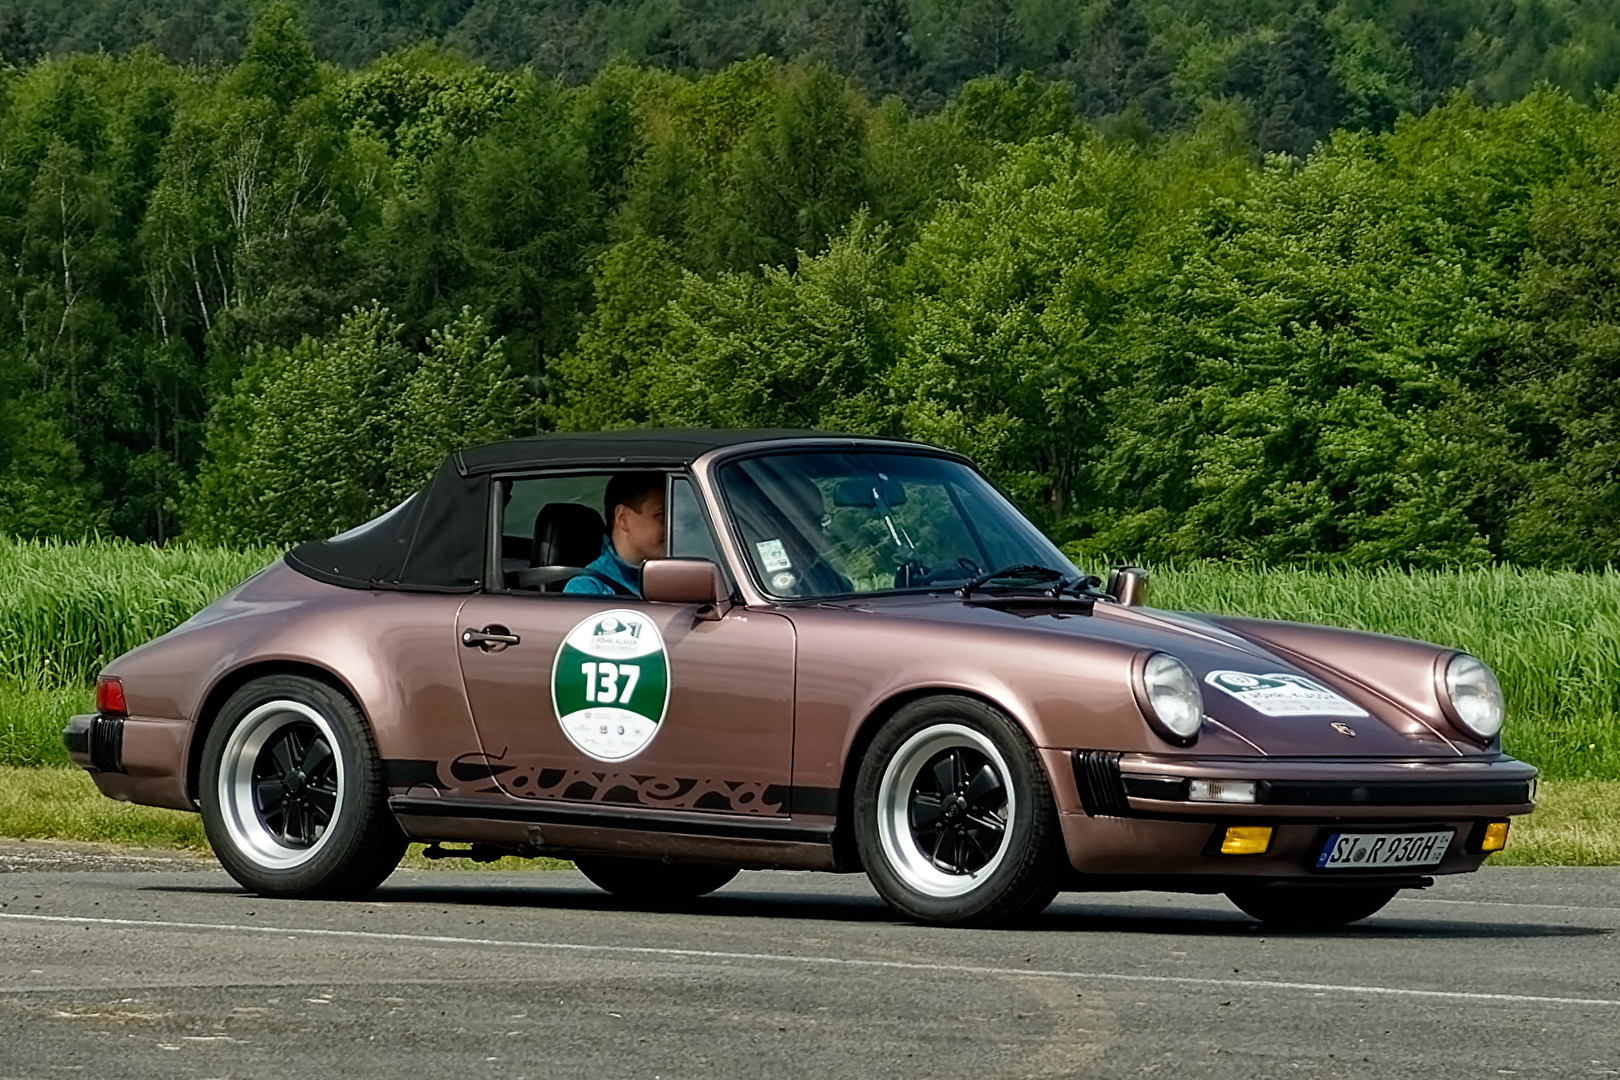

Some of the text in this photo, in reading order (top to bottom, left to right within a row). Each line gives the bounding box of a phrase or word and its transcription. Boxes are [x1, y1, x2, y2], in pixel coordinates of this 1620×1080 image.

[581, 662, 640, 704] 137
[436, 746, 783, 813] Carrera
[1330, 836, 1439, 863] SI R 930H
